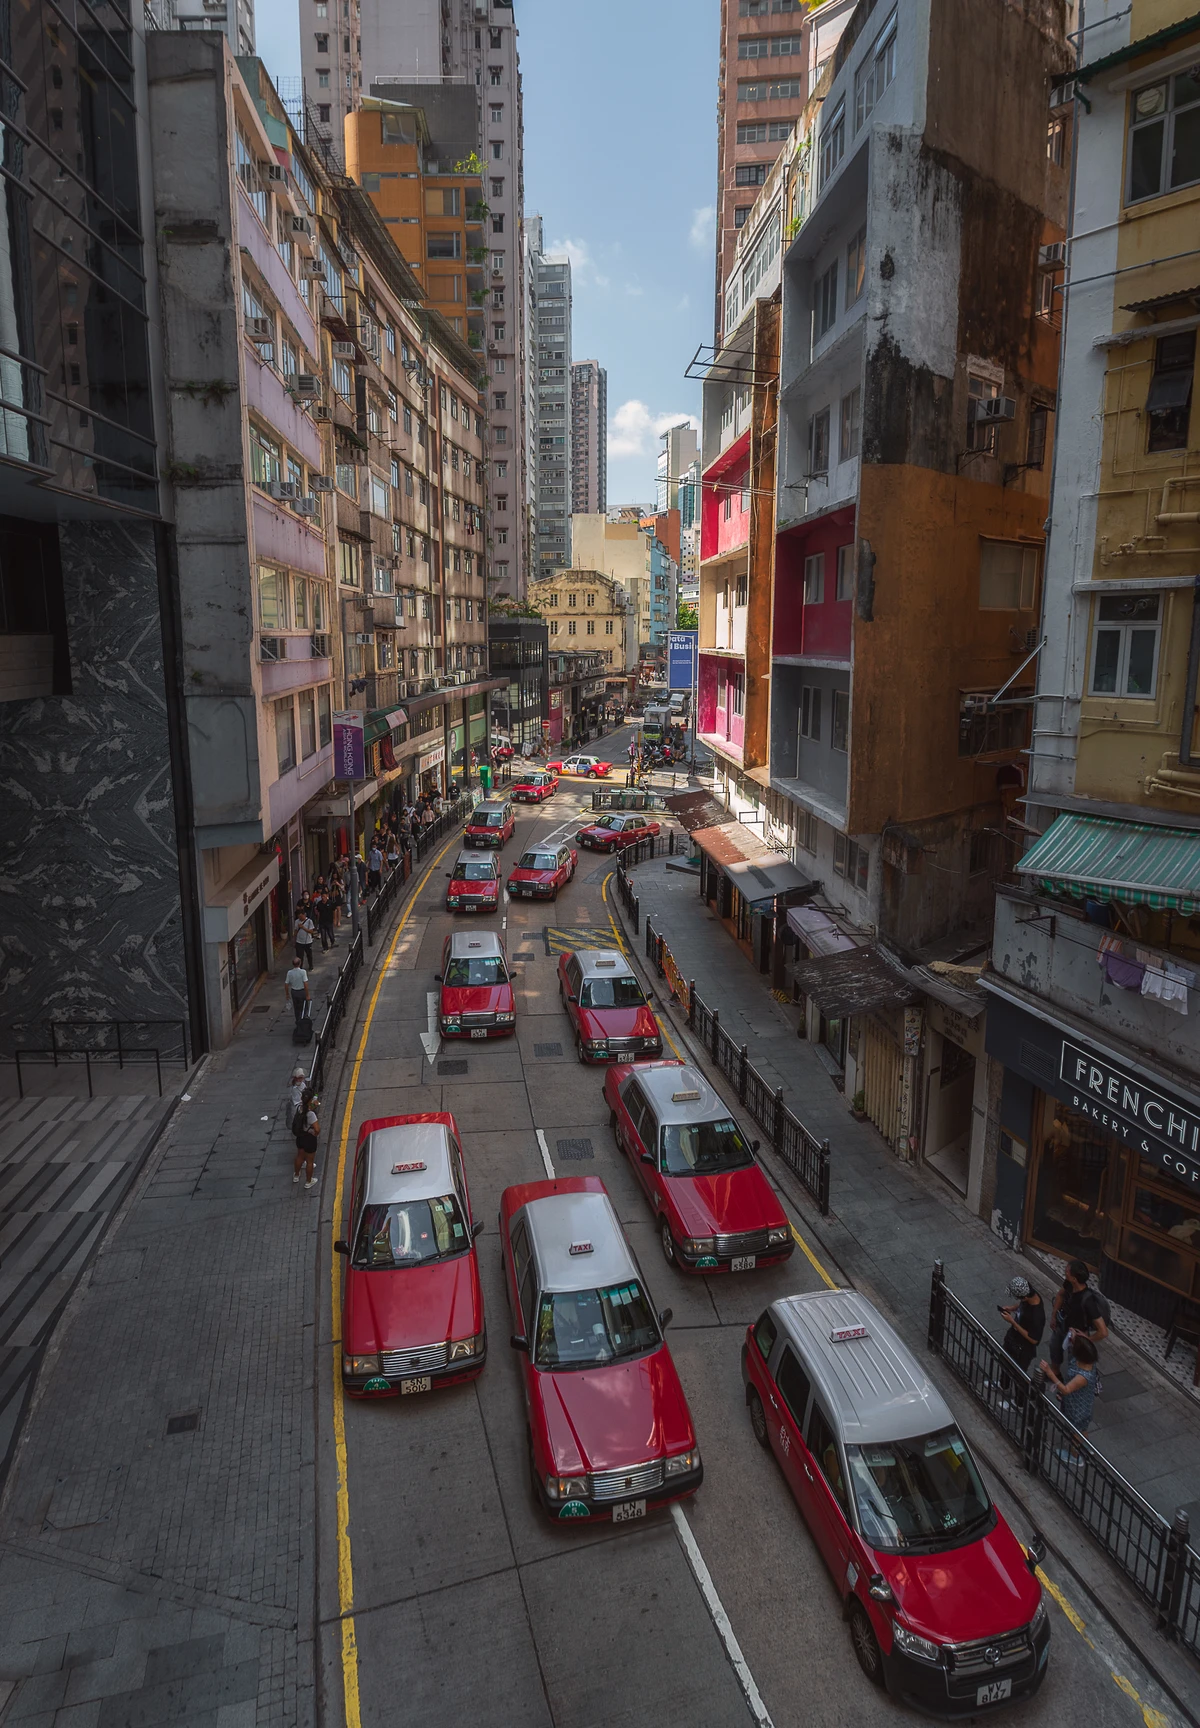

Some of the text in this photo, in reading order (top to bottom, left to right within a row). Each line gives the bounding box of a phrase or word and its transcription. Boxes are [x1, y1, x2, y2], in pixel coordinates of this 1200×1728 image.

[347, 752, 355, 776] KONG
[1072, 1096, 1130, 1138] BAKERY
[1140, 1139, 1150, 1152] &
[396, 1162, 424, 1171] TAXI
[573, 1243, 591, 1252] TAXI
[837, 1328, 866, 1338] TAXI
[410, 1378, 423, 1387] SN
[405, 1384, 428, 1394] 5019
[616, 1508, 643, 1521] 5348
[982, 1689, 1006, 1704] 8147
